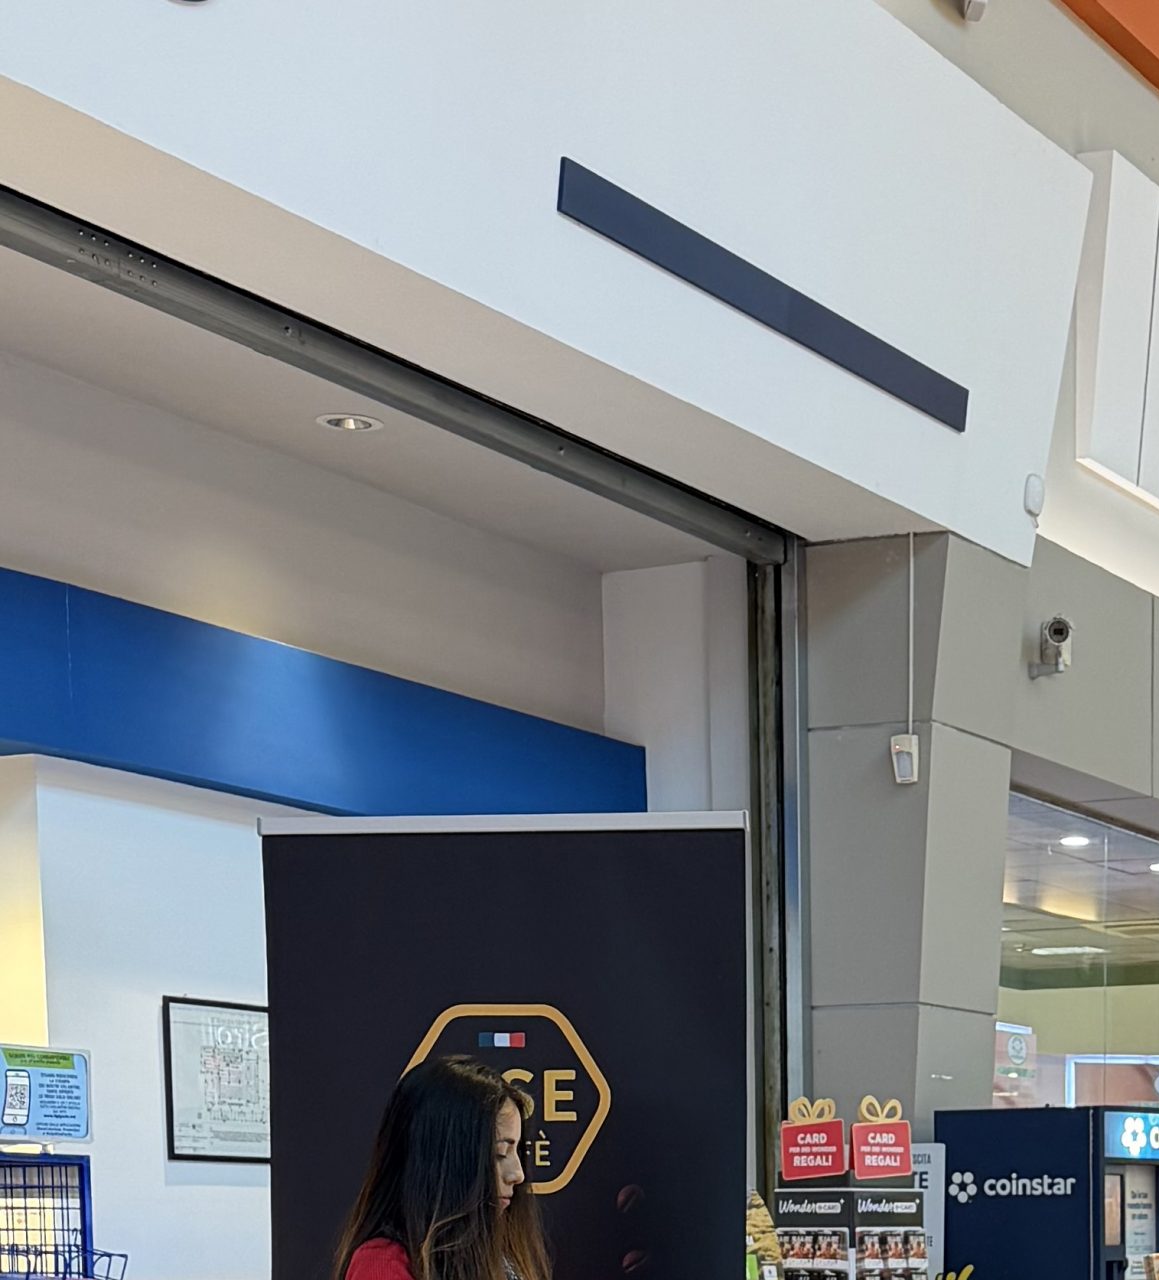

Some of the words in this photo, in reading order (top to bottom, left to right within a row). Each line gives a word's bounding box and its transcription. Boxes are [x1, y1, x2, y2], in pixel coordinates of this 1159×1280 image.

[797, 1133, 828, 1144] CARD
[867, 1132, 896, 1144] CARD
[793, 1155, 832, 1167] REGALI
[865, 1155, 900, 1167] REGALI
[983, 1172, 1076, 1196] coinstar
[778, 1199, 816, 1214] Wonder
[857, 1198, 893, 1214] Wonder
